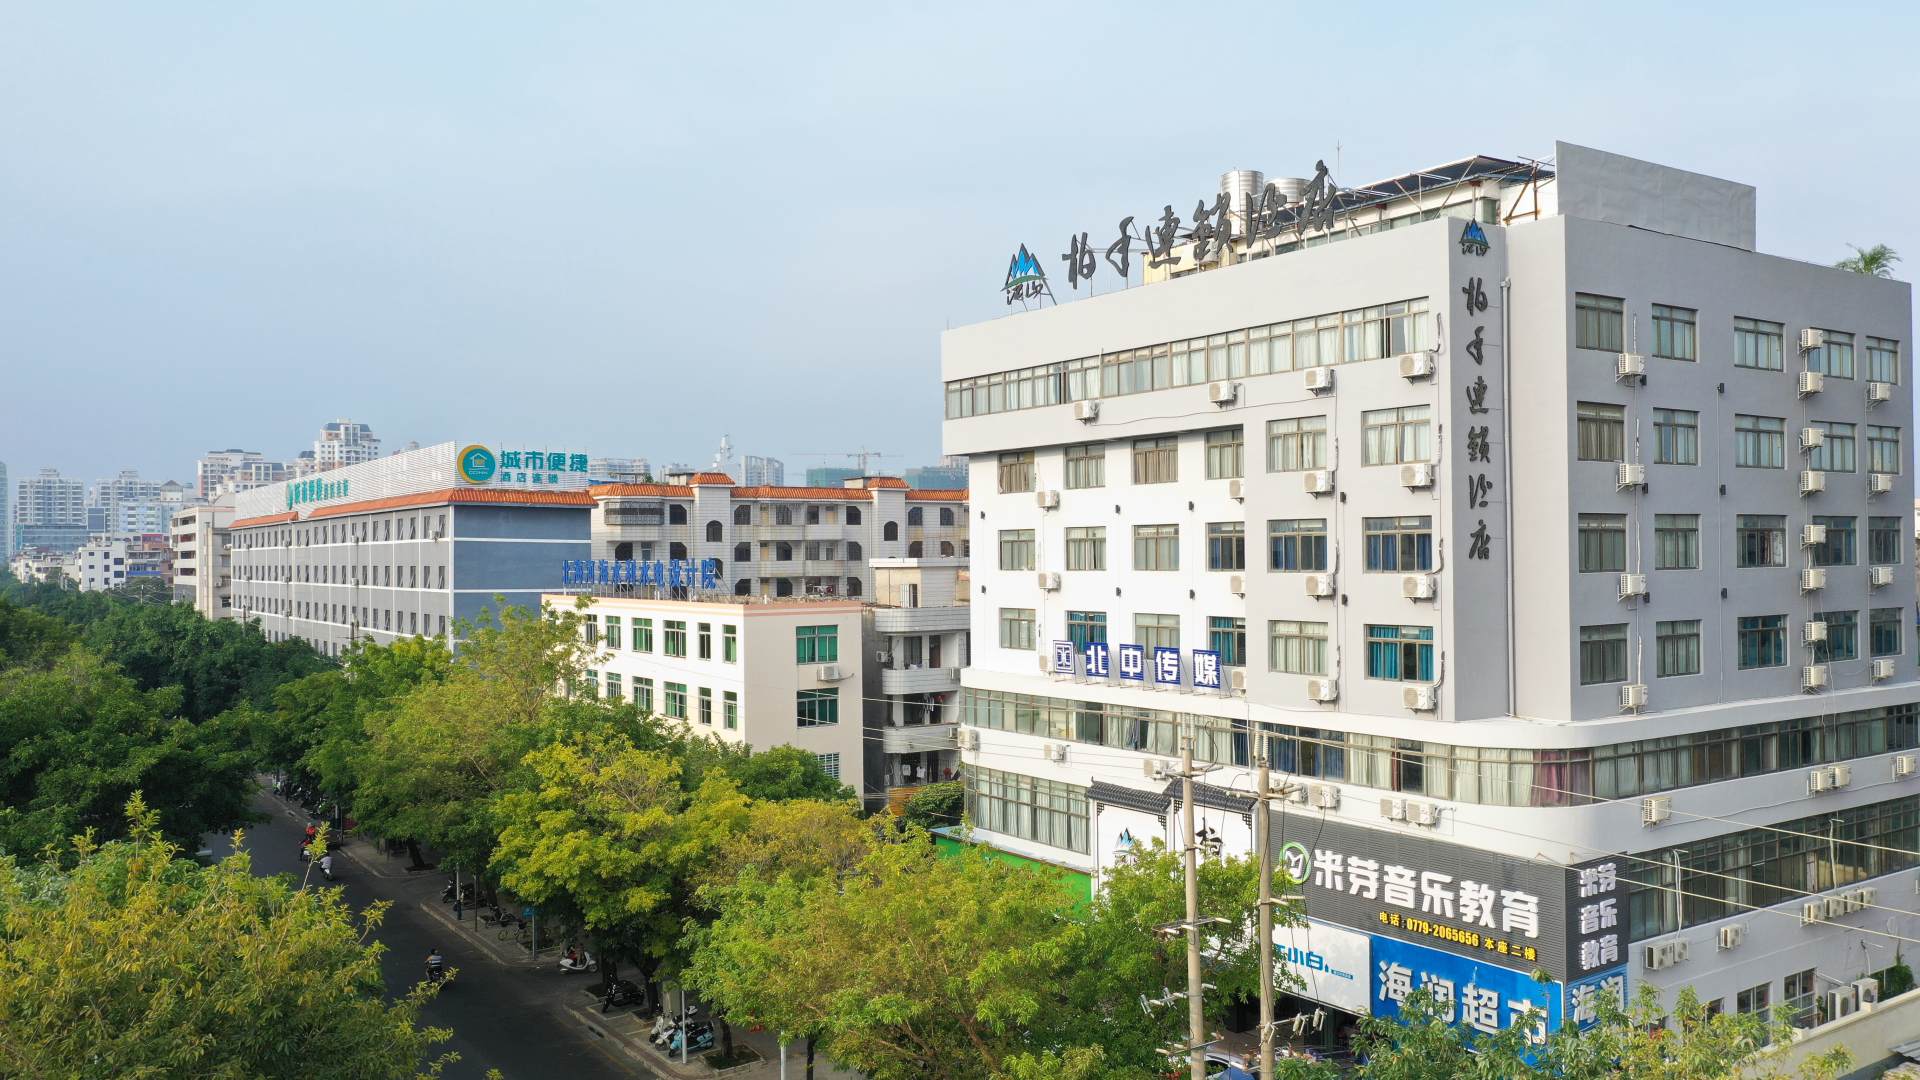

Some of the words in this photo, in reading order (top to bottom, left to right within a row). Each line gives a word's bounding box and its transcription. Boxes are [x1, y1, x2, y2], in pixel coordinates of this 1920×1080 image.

[500, 450, 588, 473] 城市便捷
[1314, 850, 1539, 938] 米芳音乐教育
[1580, 862, 1617, 897] 米芳
[1581, 898, 1618, 934] 音乐
[1484, 937, 1537, 961] 本座二楼
[1582, 934, 1618, 970] 教育
